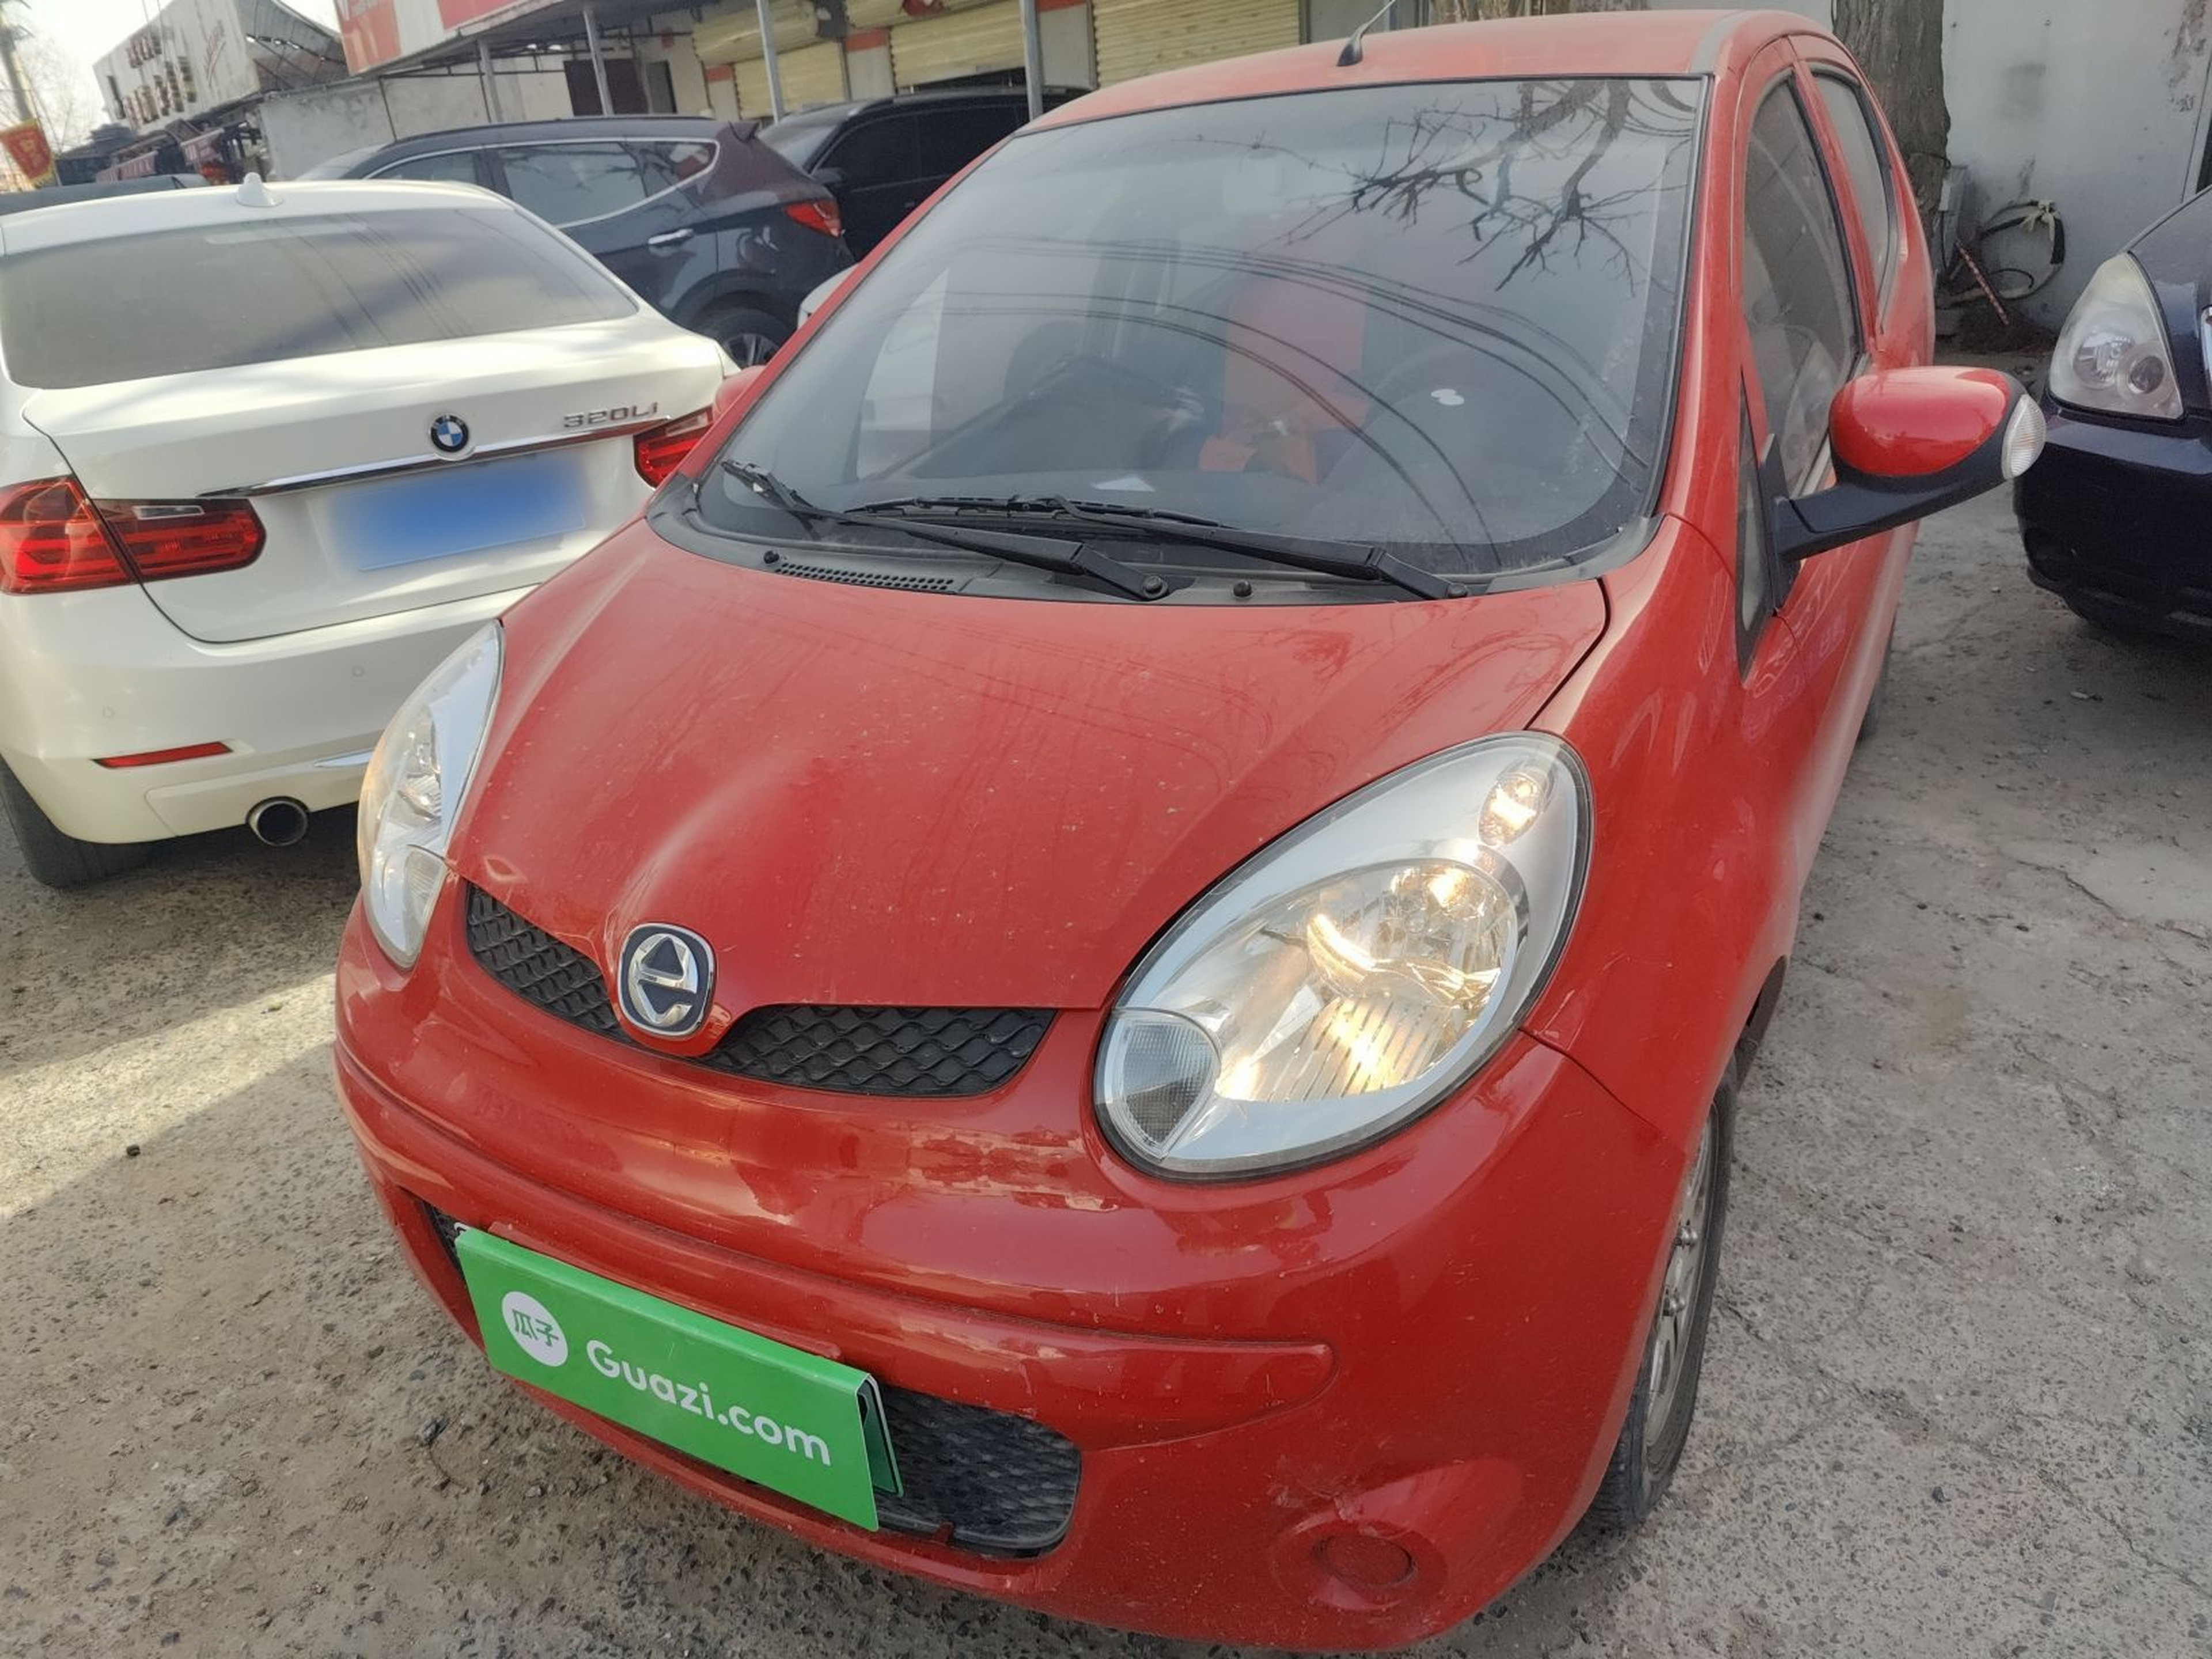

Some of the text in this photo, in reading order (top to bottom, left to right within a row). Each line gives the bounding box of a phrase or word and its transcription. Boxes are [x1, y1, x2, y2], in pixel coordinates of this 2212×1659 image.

[563, 402, 658, 427] 320Li
[512, 1308, 559, 1347] 瓜子
[586, 1340, 831, 1465] Guazi.com
